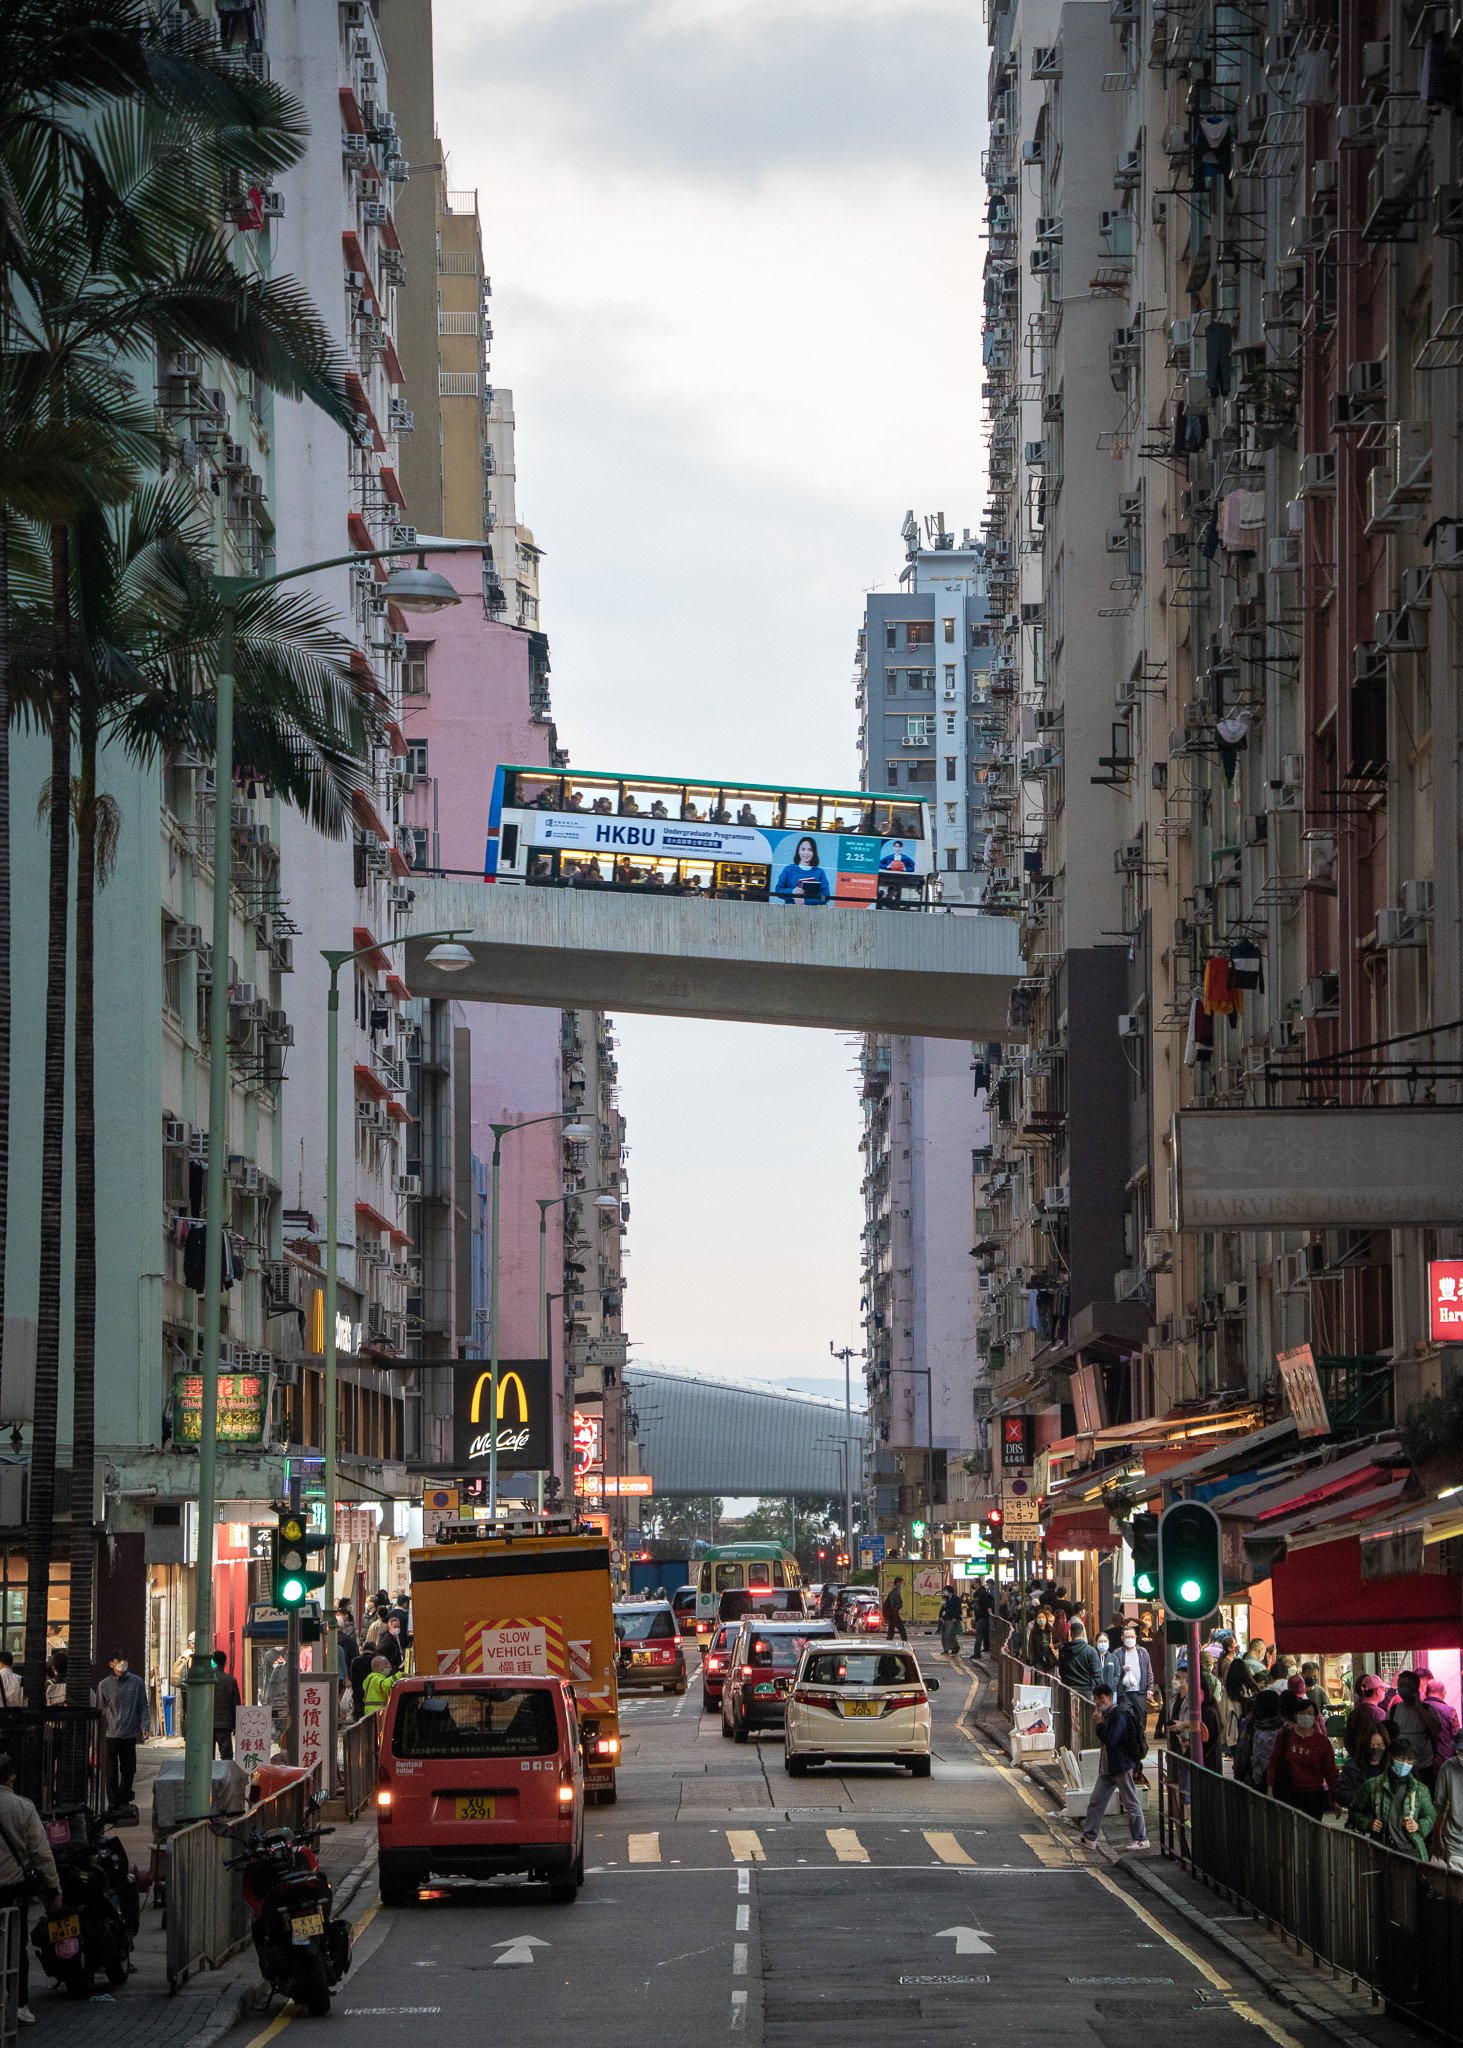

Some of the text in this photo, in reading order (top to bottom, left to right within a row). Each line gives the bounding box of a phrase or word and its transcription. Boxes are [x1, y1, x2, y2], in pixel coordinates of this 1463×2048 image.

[596, 824, 655, 846] HKBU
[663, 828, 755, 841] Undergraduate Programmes
[846, 852, 865, 862] 2.25
[1192, 1199, 1315, 1218] HARVEST
[1006, 1444, 1024, 1454] DBS
[1016, 1500, 1037, 1509] 8-10
[499, 1632, 530, 1644] SLOW
[487, 1645, 542, 1658] VEHICLE
[498, 1661, 533, 1674] 慢車
[852, 1708, 871, 1716] 3013
[468, 1799, 484, 1808] XU
[460, 1808, 491, 1819] 3291
[294, 1924, 322, 1937] 5637
